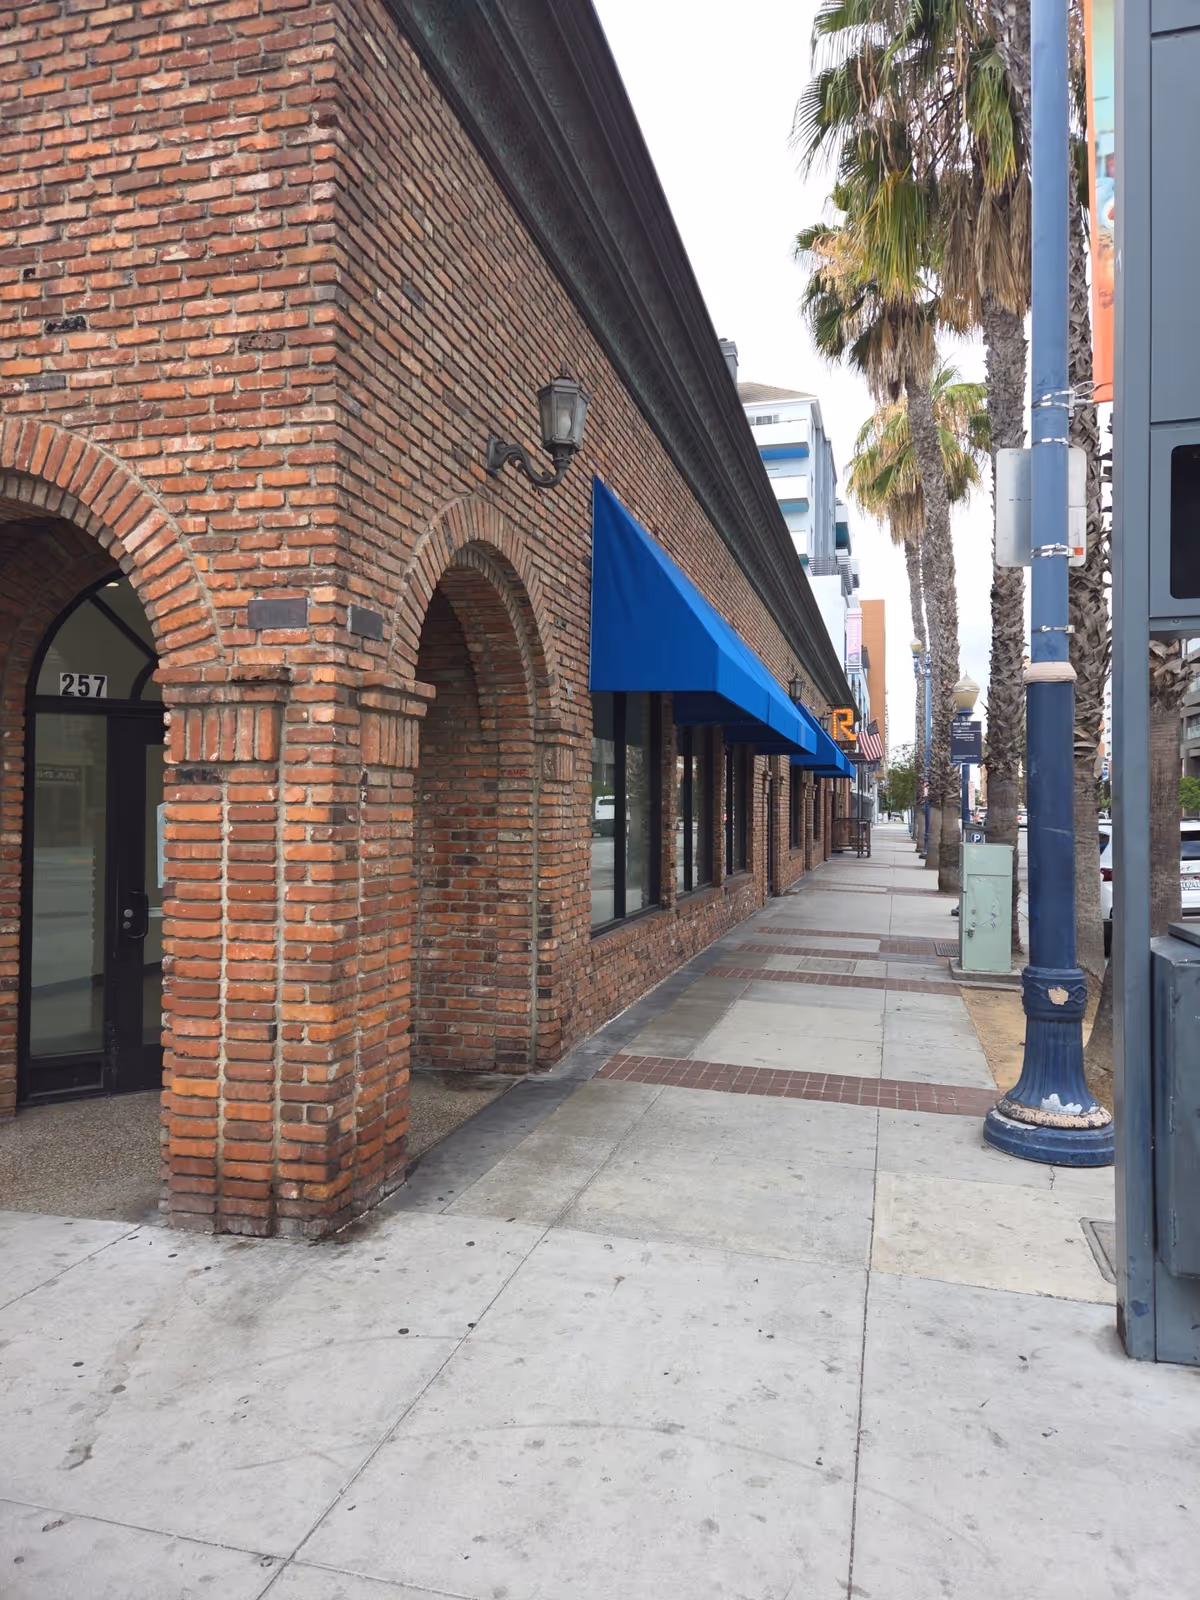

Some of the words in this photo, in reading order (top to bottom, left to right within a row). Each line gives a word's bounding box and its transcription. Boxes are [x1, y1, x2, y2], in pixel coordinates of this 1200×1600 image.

[61, 673, 106, 698] 257
[832, 708, 857, 741] R
[973, 834, 981, 843] P
